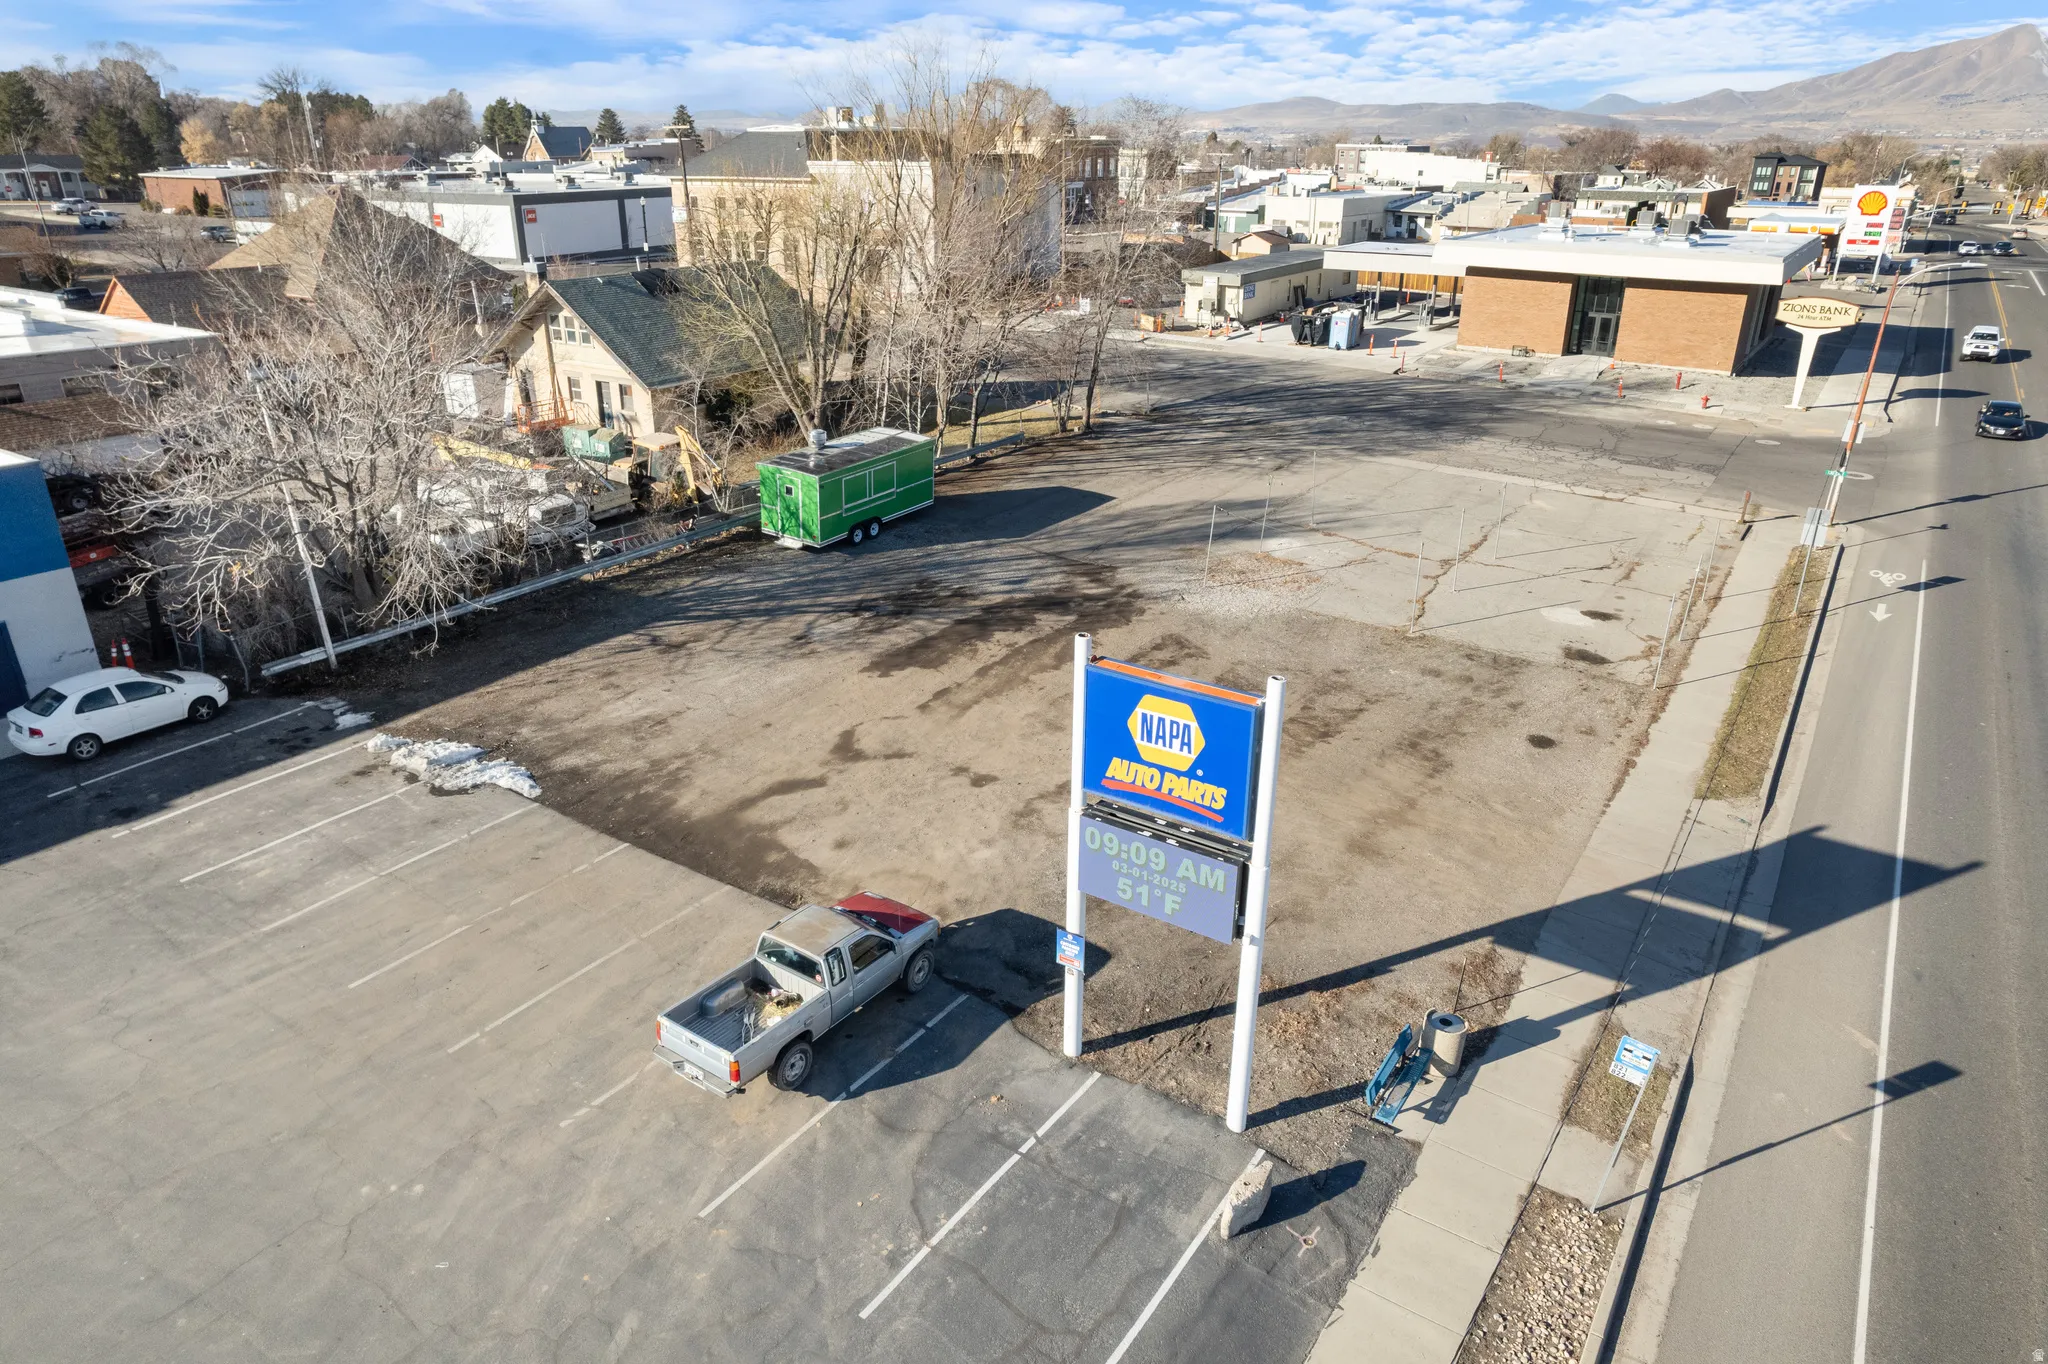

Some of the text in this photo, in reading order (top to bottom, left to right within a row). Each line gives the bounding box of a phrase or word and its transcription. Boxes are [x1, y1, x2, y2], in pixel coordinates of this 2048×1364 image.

[1783, 303, 1852, 316] ZIONS BANK
[1140, 711, 1192, 755] NAPA
[1105, 756, 1227, 810] AUTO PARTS
[1085, 826, 1225, 892] 09:09 AM
[1112, 860, 1186, 893] 03-01-2025
